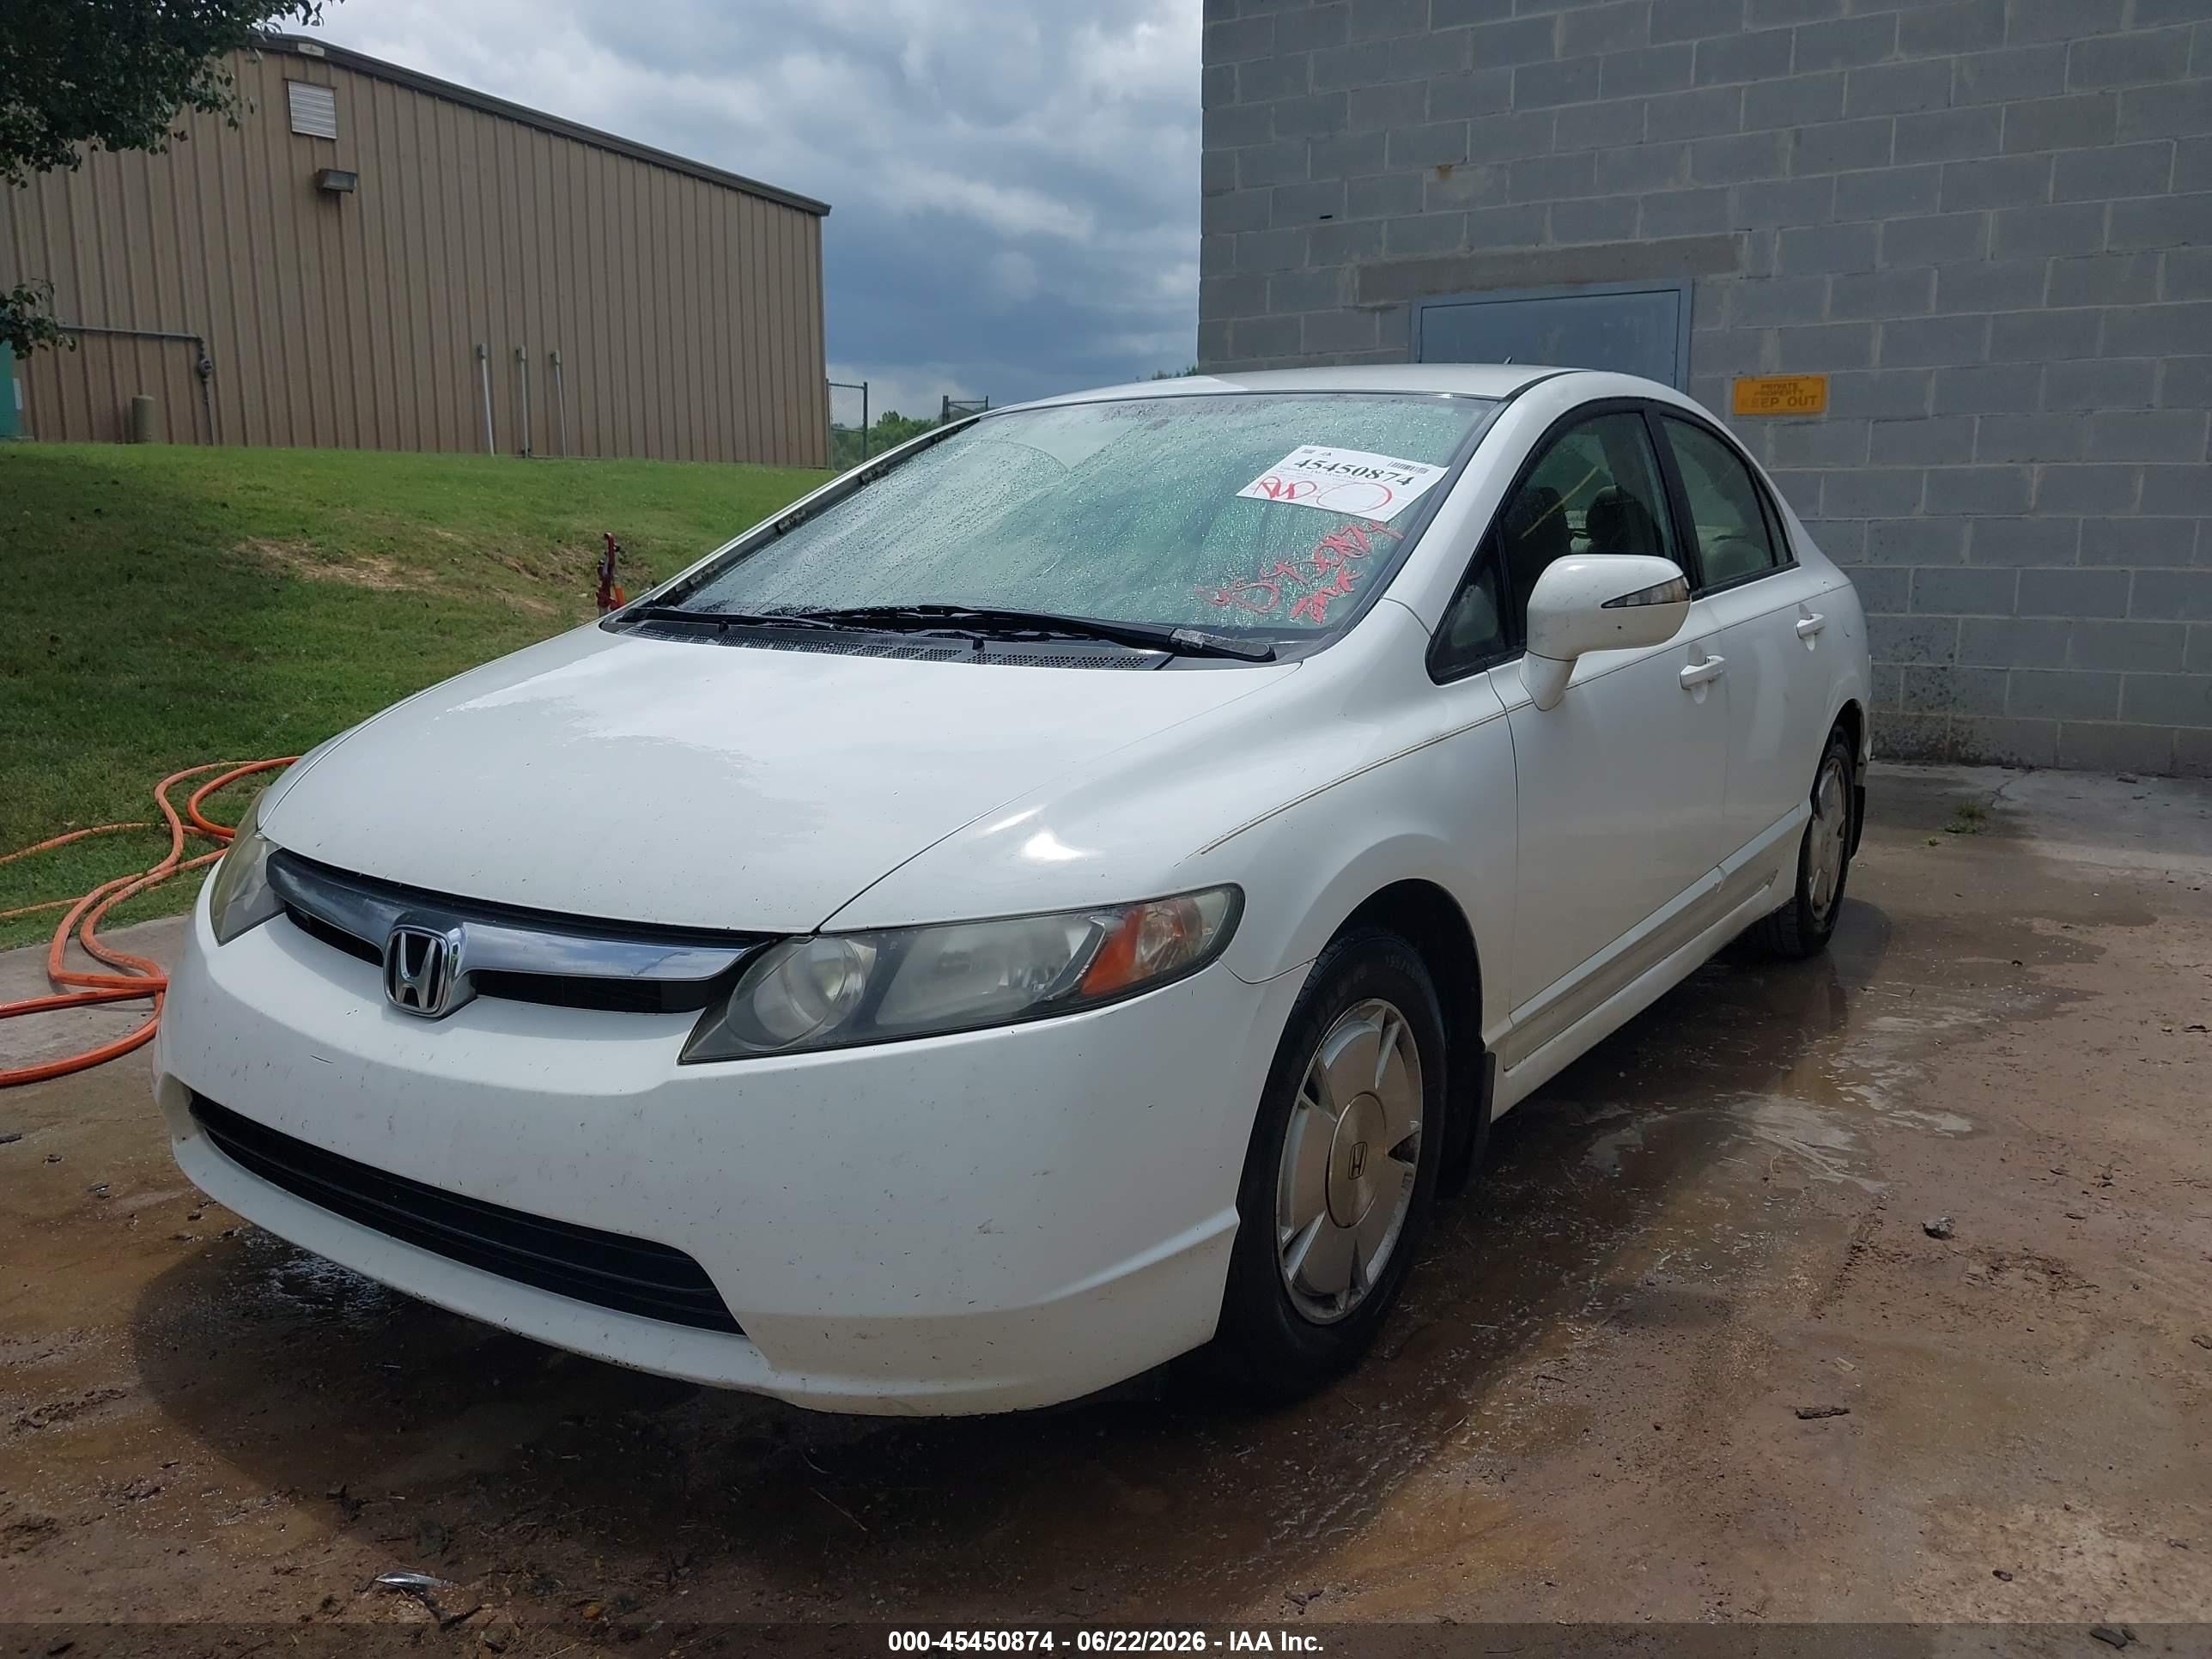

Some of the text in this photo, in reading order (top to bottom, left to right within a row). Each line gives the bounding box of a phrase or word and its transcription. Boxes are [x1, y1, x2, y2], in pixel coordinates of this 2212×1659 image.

[1761, 382, 1799, 392] PRIVATE
[1787, 395, 1818, 406] OUT
[1293, 459, 1415, 486] 45450874
